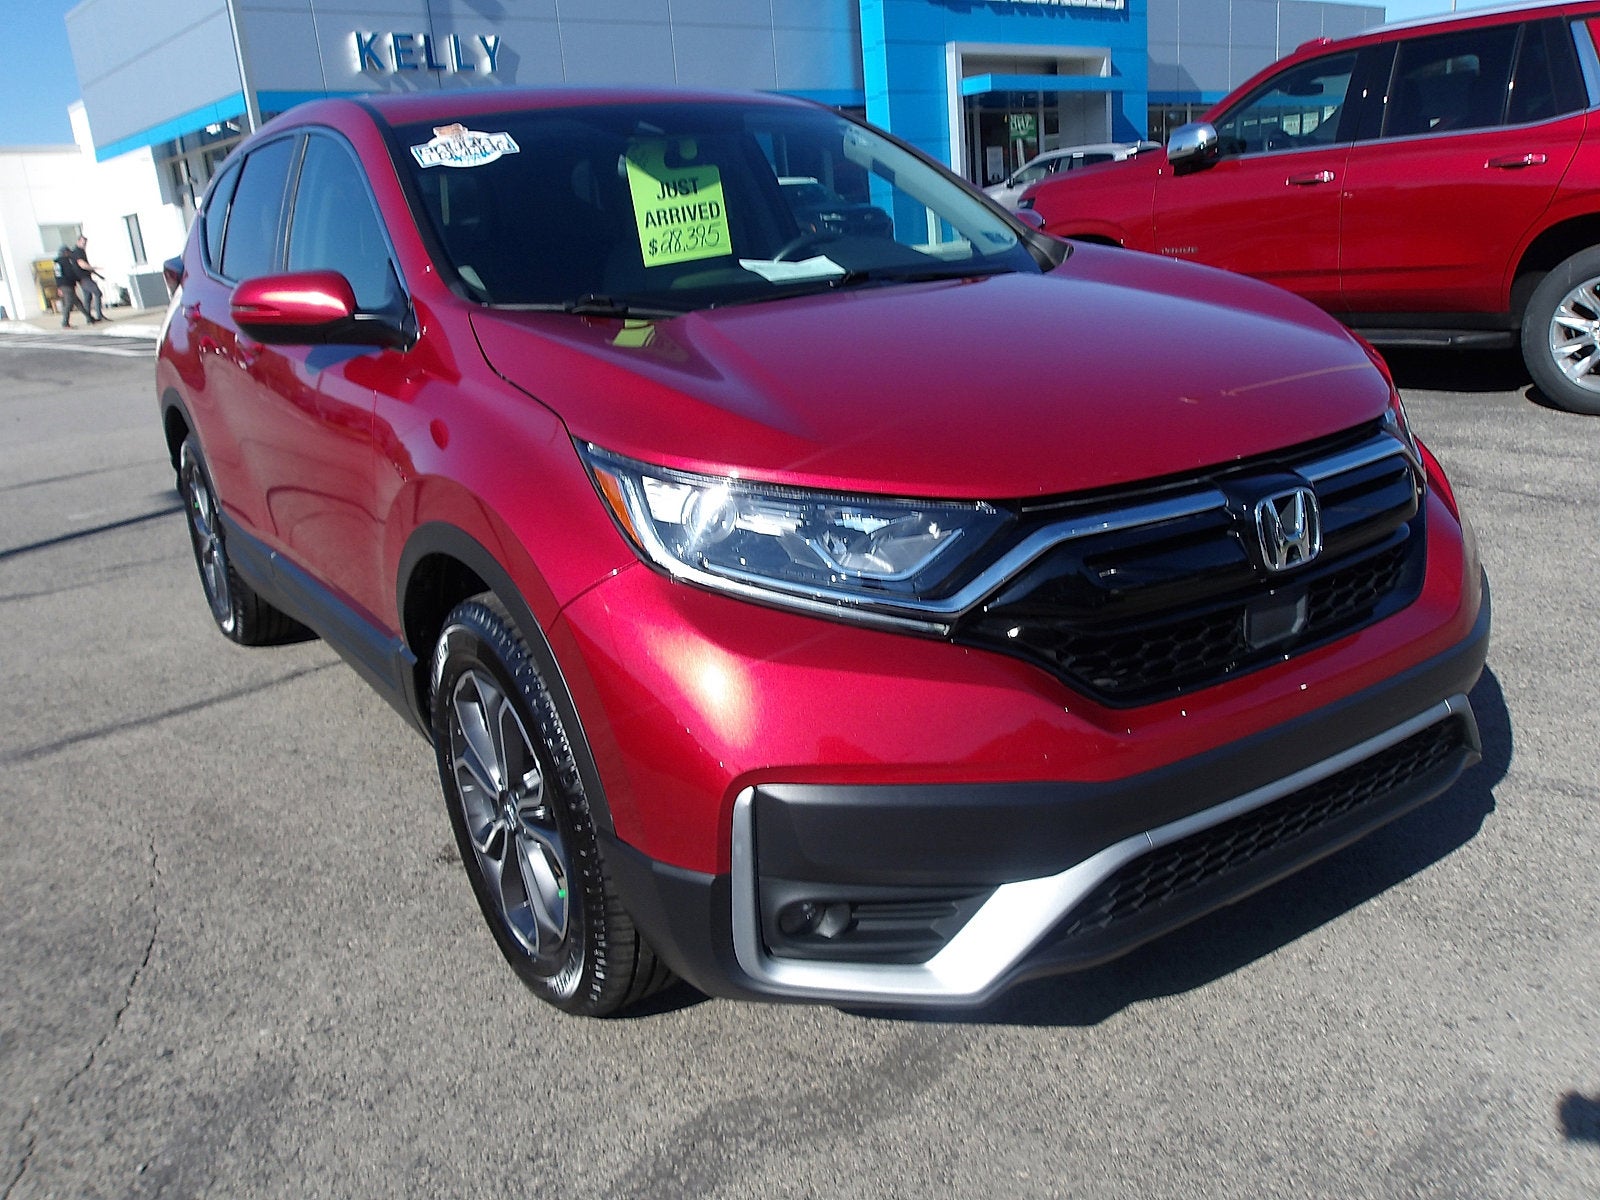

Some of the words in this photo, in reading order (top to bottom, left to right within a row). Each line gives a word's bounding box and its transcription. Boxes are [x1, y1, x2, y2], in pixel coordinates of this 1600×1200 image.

[350, 31, 500, 73] KELLY
[657, 177, 698, 199] JUST
[645, 201, 721, 228] ARRIVED
